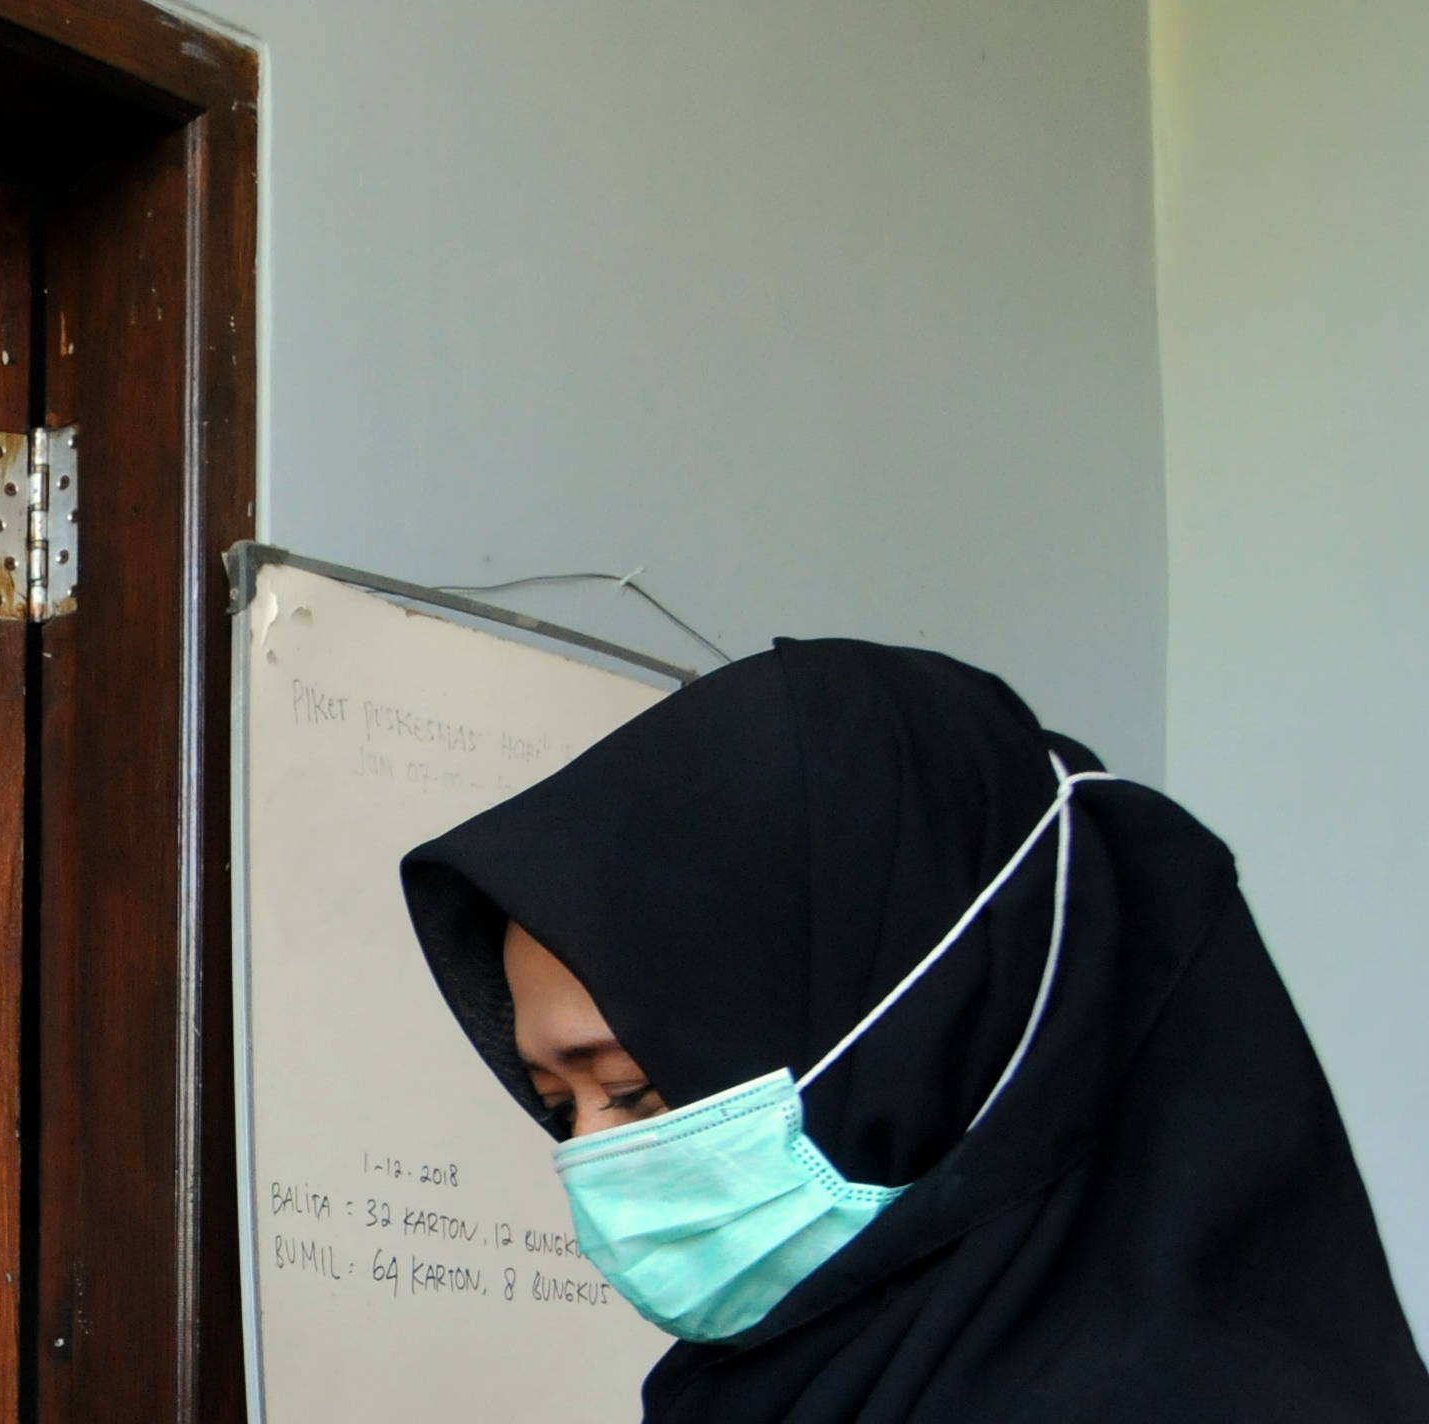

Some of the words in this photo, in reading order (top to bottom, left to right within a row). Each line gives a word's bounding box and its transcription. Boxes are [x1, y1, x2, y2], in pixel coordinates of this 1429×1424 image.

[366, 1198, 391, 1228] 32
[495, 1223, 513, 1248] 12
[275, 1234, 341, 1280] BUMIL
[372, 1248, 398, 1297] 64
[504, 1267, 515, 1300] 8
[532, 1270, 609, 1306] BUNGKUS
